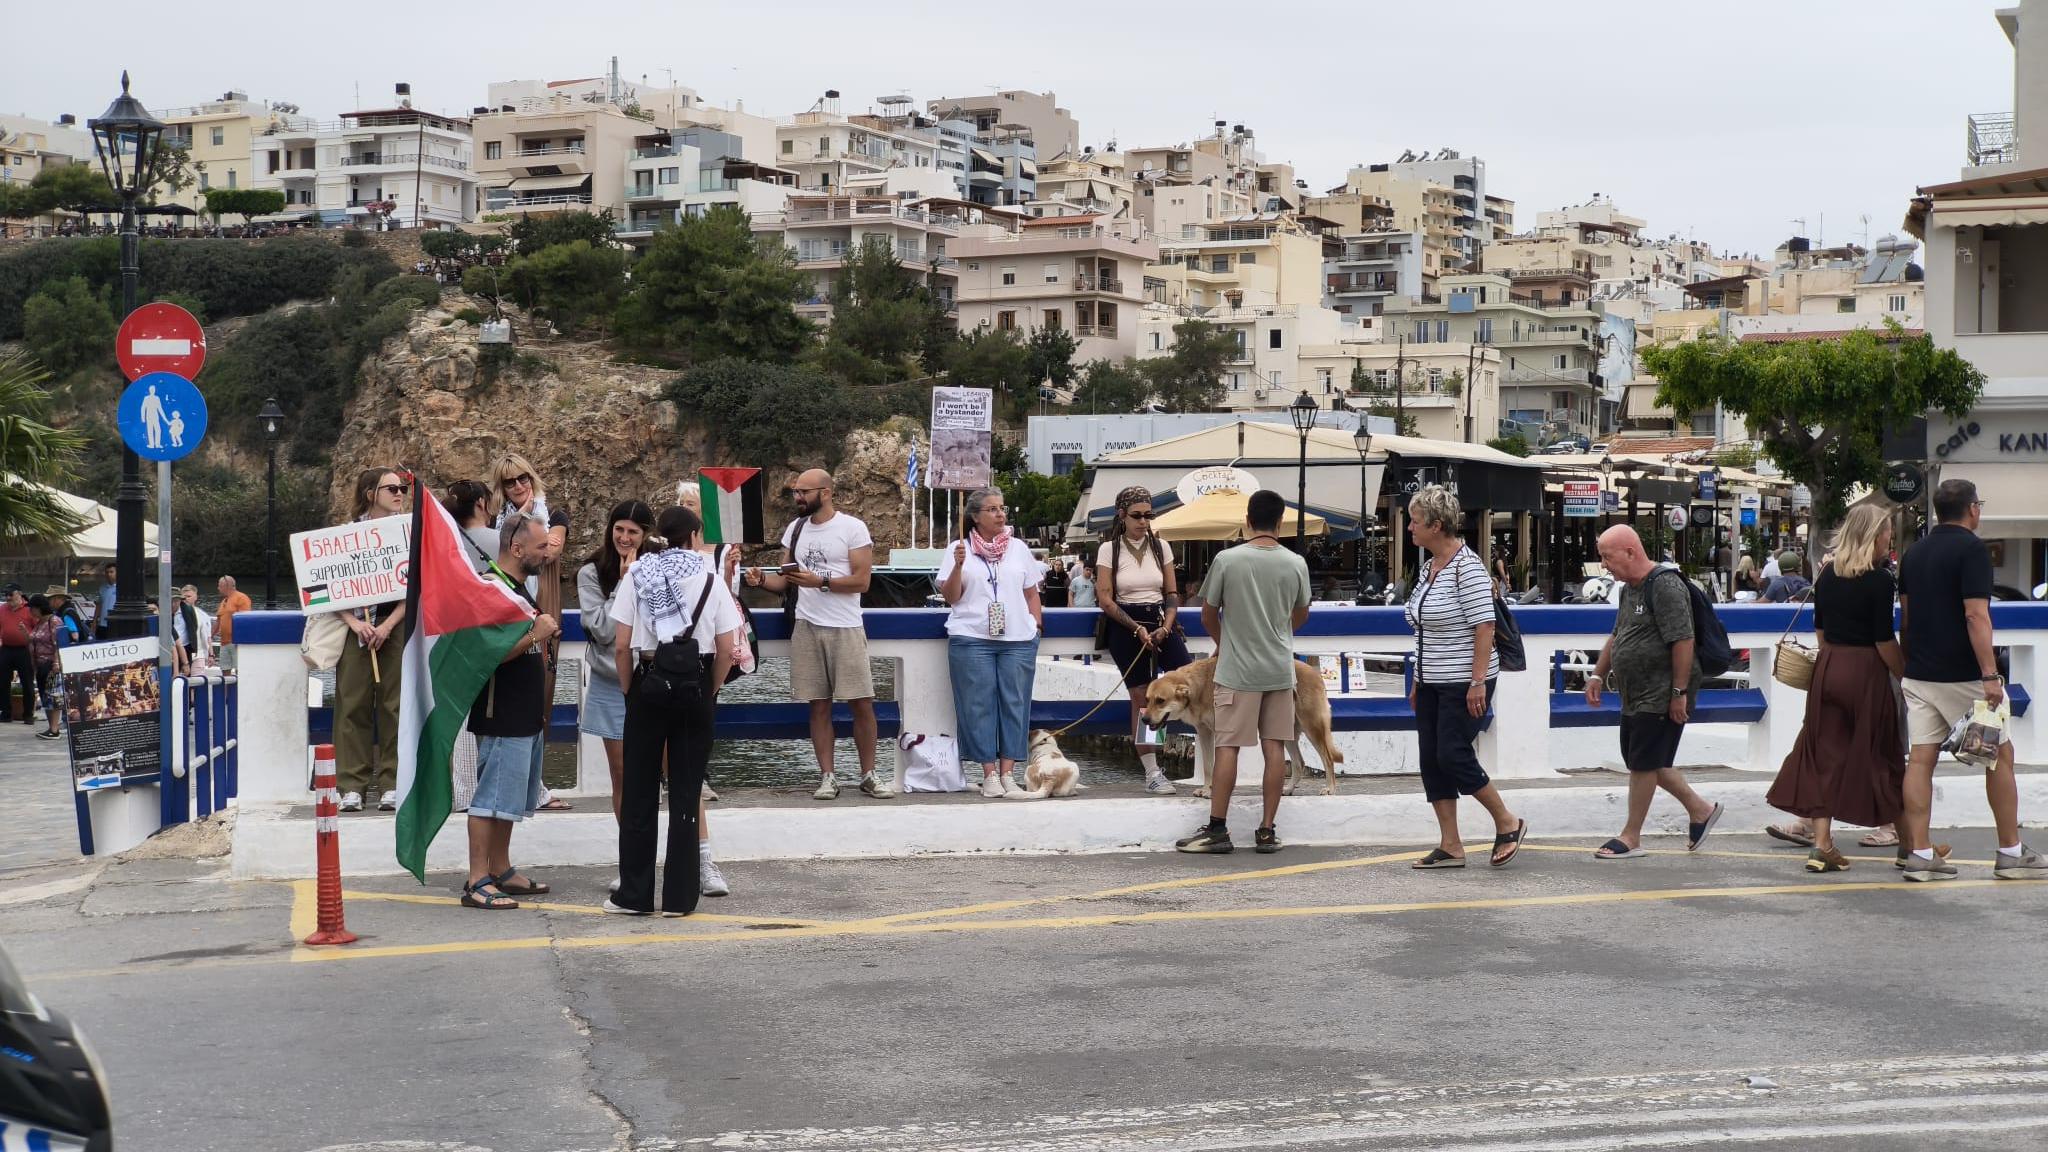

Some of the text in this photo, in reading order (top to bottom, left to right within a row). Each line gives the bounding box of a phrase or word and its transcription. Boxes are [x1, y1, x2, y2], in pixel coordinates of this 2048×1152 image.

[1999, 432, 2048, 453] KAN
[303, 528, 383, 562] ISRAELIS
[350, 545, 403, 561] WELCOME
[310, 556, 395, 583] SUPPORTERS OF
[330, 571, 397, 600] GENOCIDE
